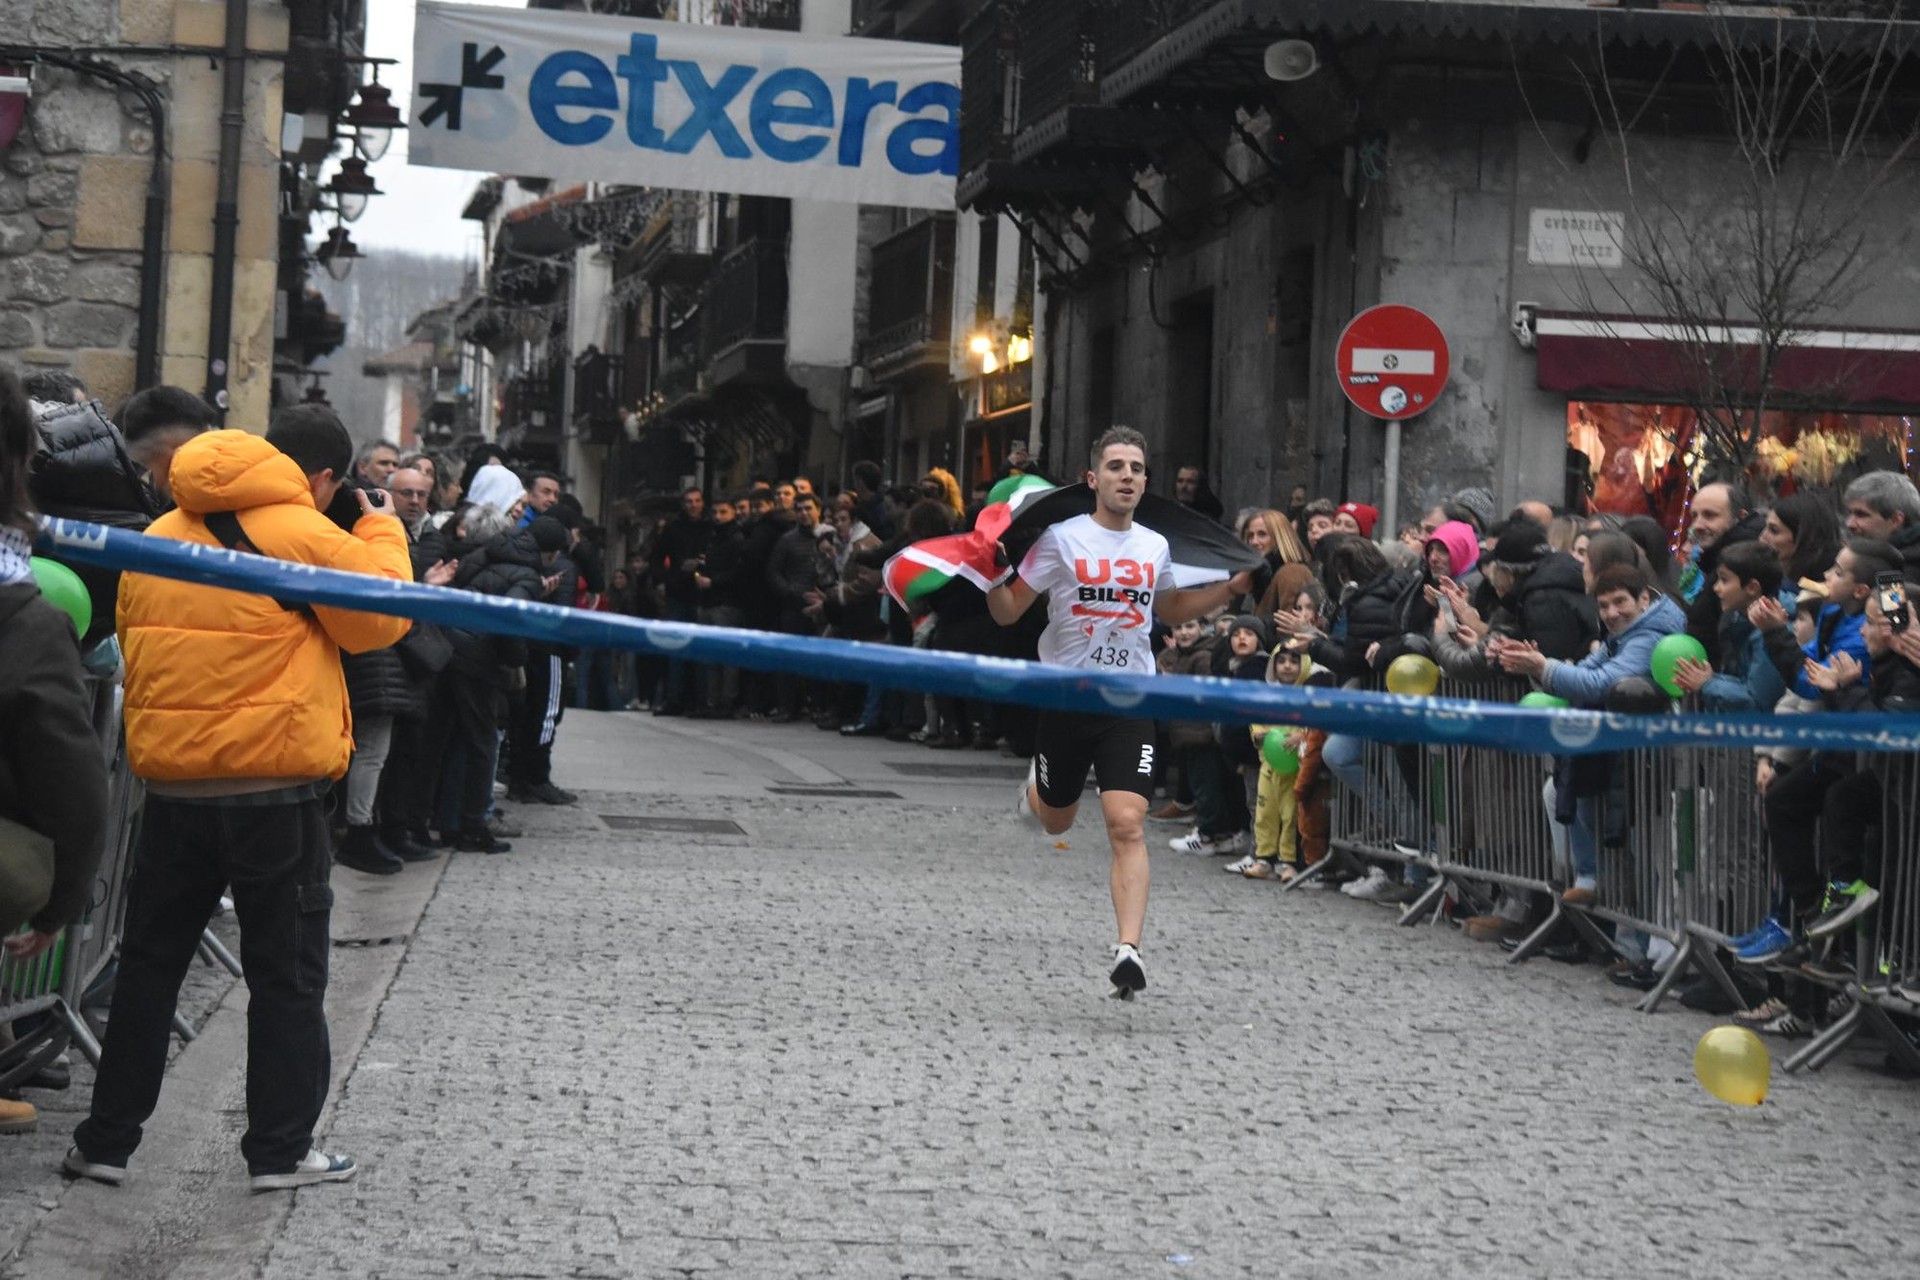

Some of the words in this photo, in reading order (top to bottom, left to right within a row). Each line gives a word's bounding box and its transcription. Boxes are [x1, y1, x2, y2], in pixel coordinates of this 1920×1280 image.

[528, 33, 960, 177] etxera
[1074, 558, 1156, 588] U31
[1078, 587, 1151, 605] BILBO
[1090, 646, 1130, 667] 438
